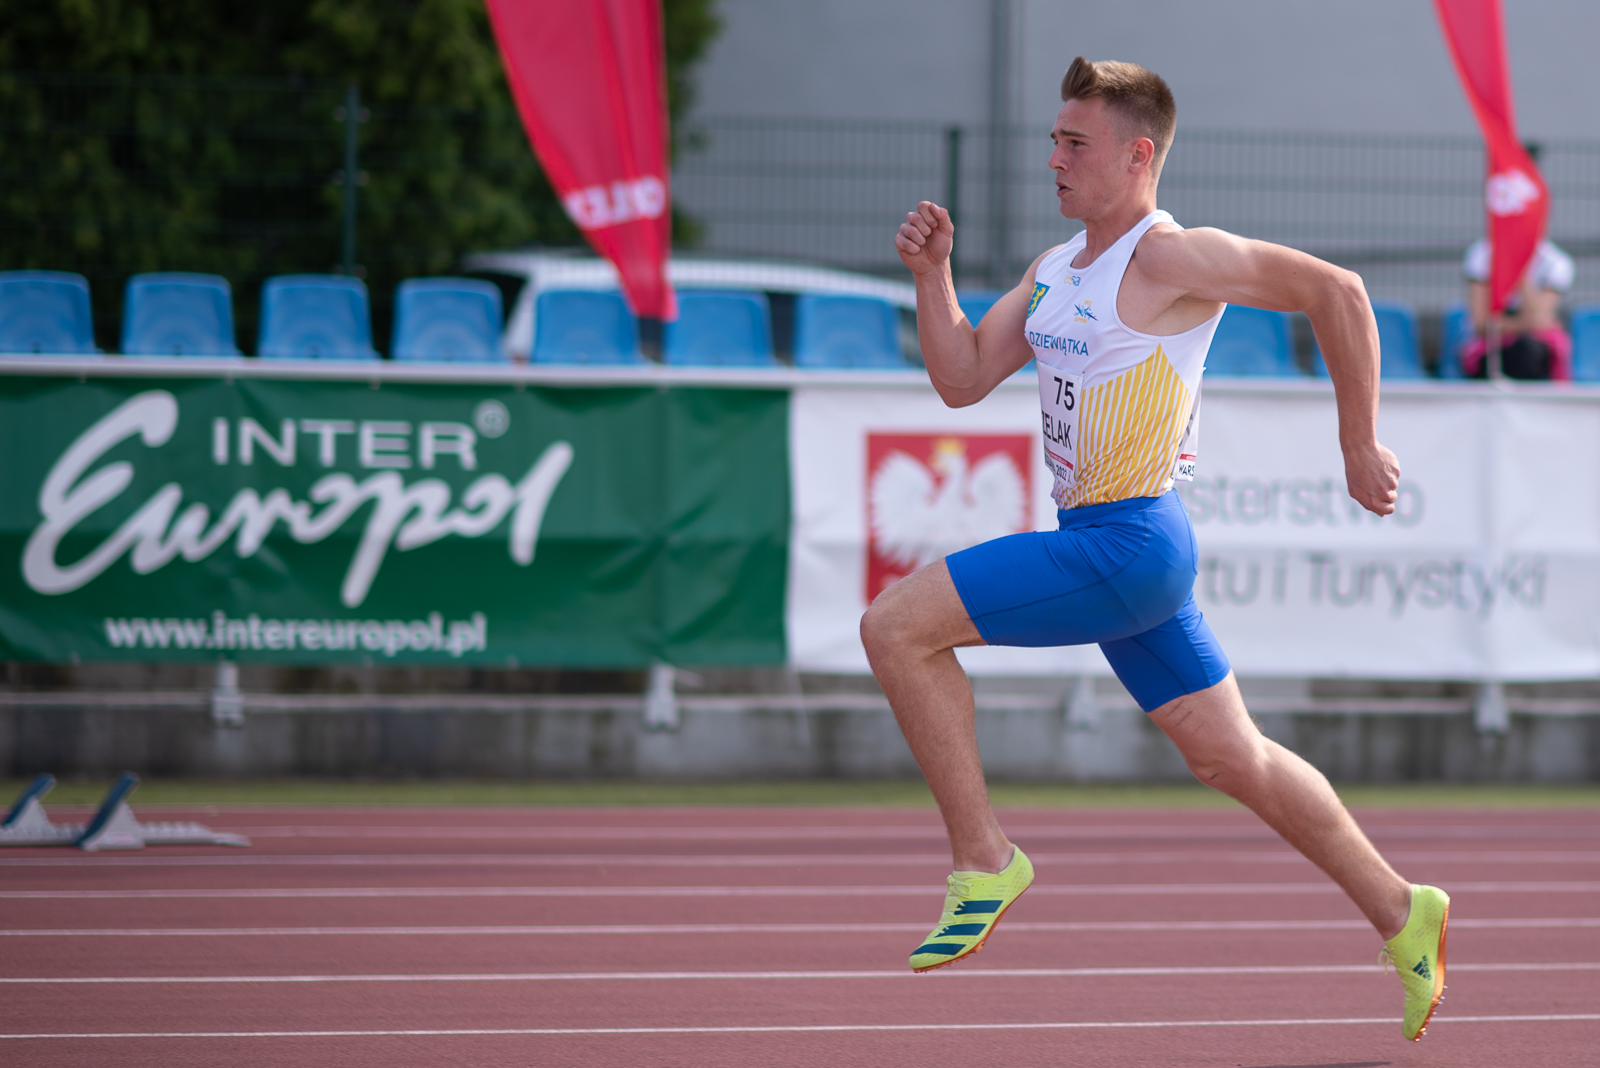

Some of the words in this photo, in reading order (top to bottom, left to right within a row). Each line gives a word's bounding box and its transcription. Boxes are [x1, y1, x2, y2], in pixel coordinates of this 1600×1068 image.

[1029, 331, 1089, 356] DZIEWIĄTKA
[1053, 375, 1075, 411] 75
[213, 418, 477, 470] INTER
[22, 391, 573, 608] Europol
[1273, 550, 1288, 604] i
[1304, 551, 1545, 621] Turystyki
[105, 610, 487, 657] www.intereuropol.pl
